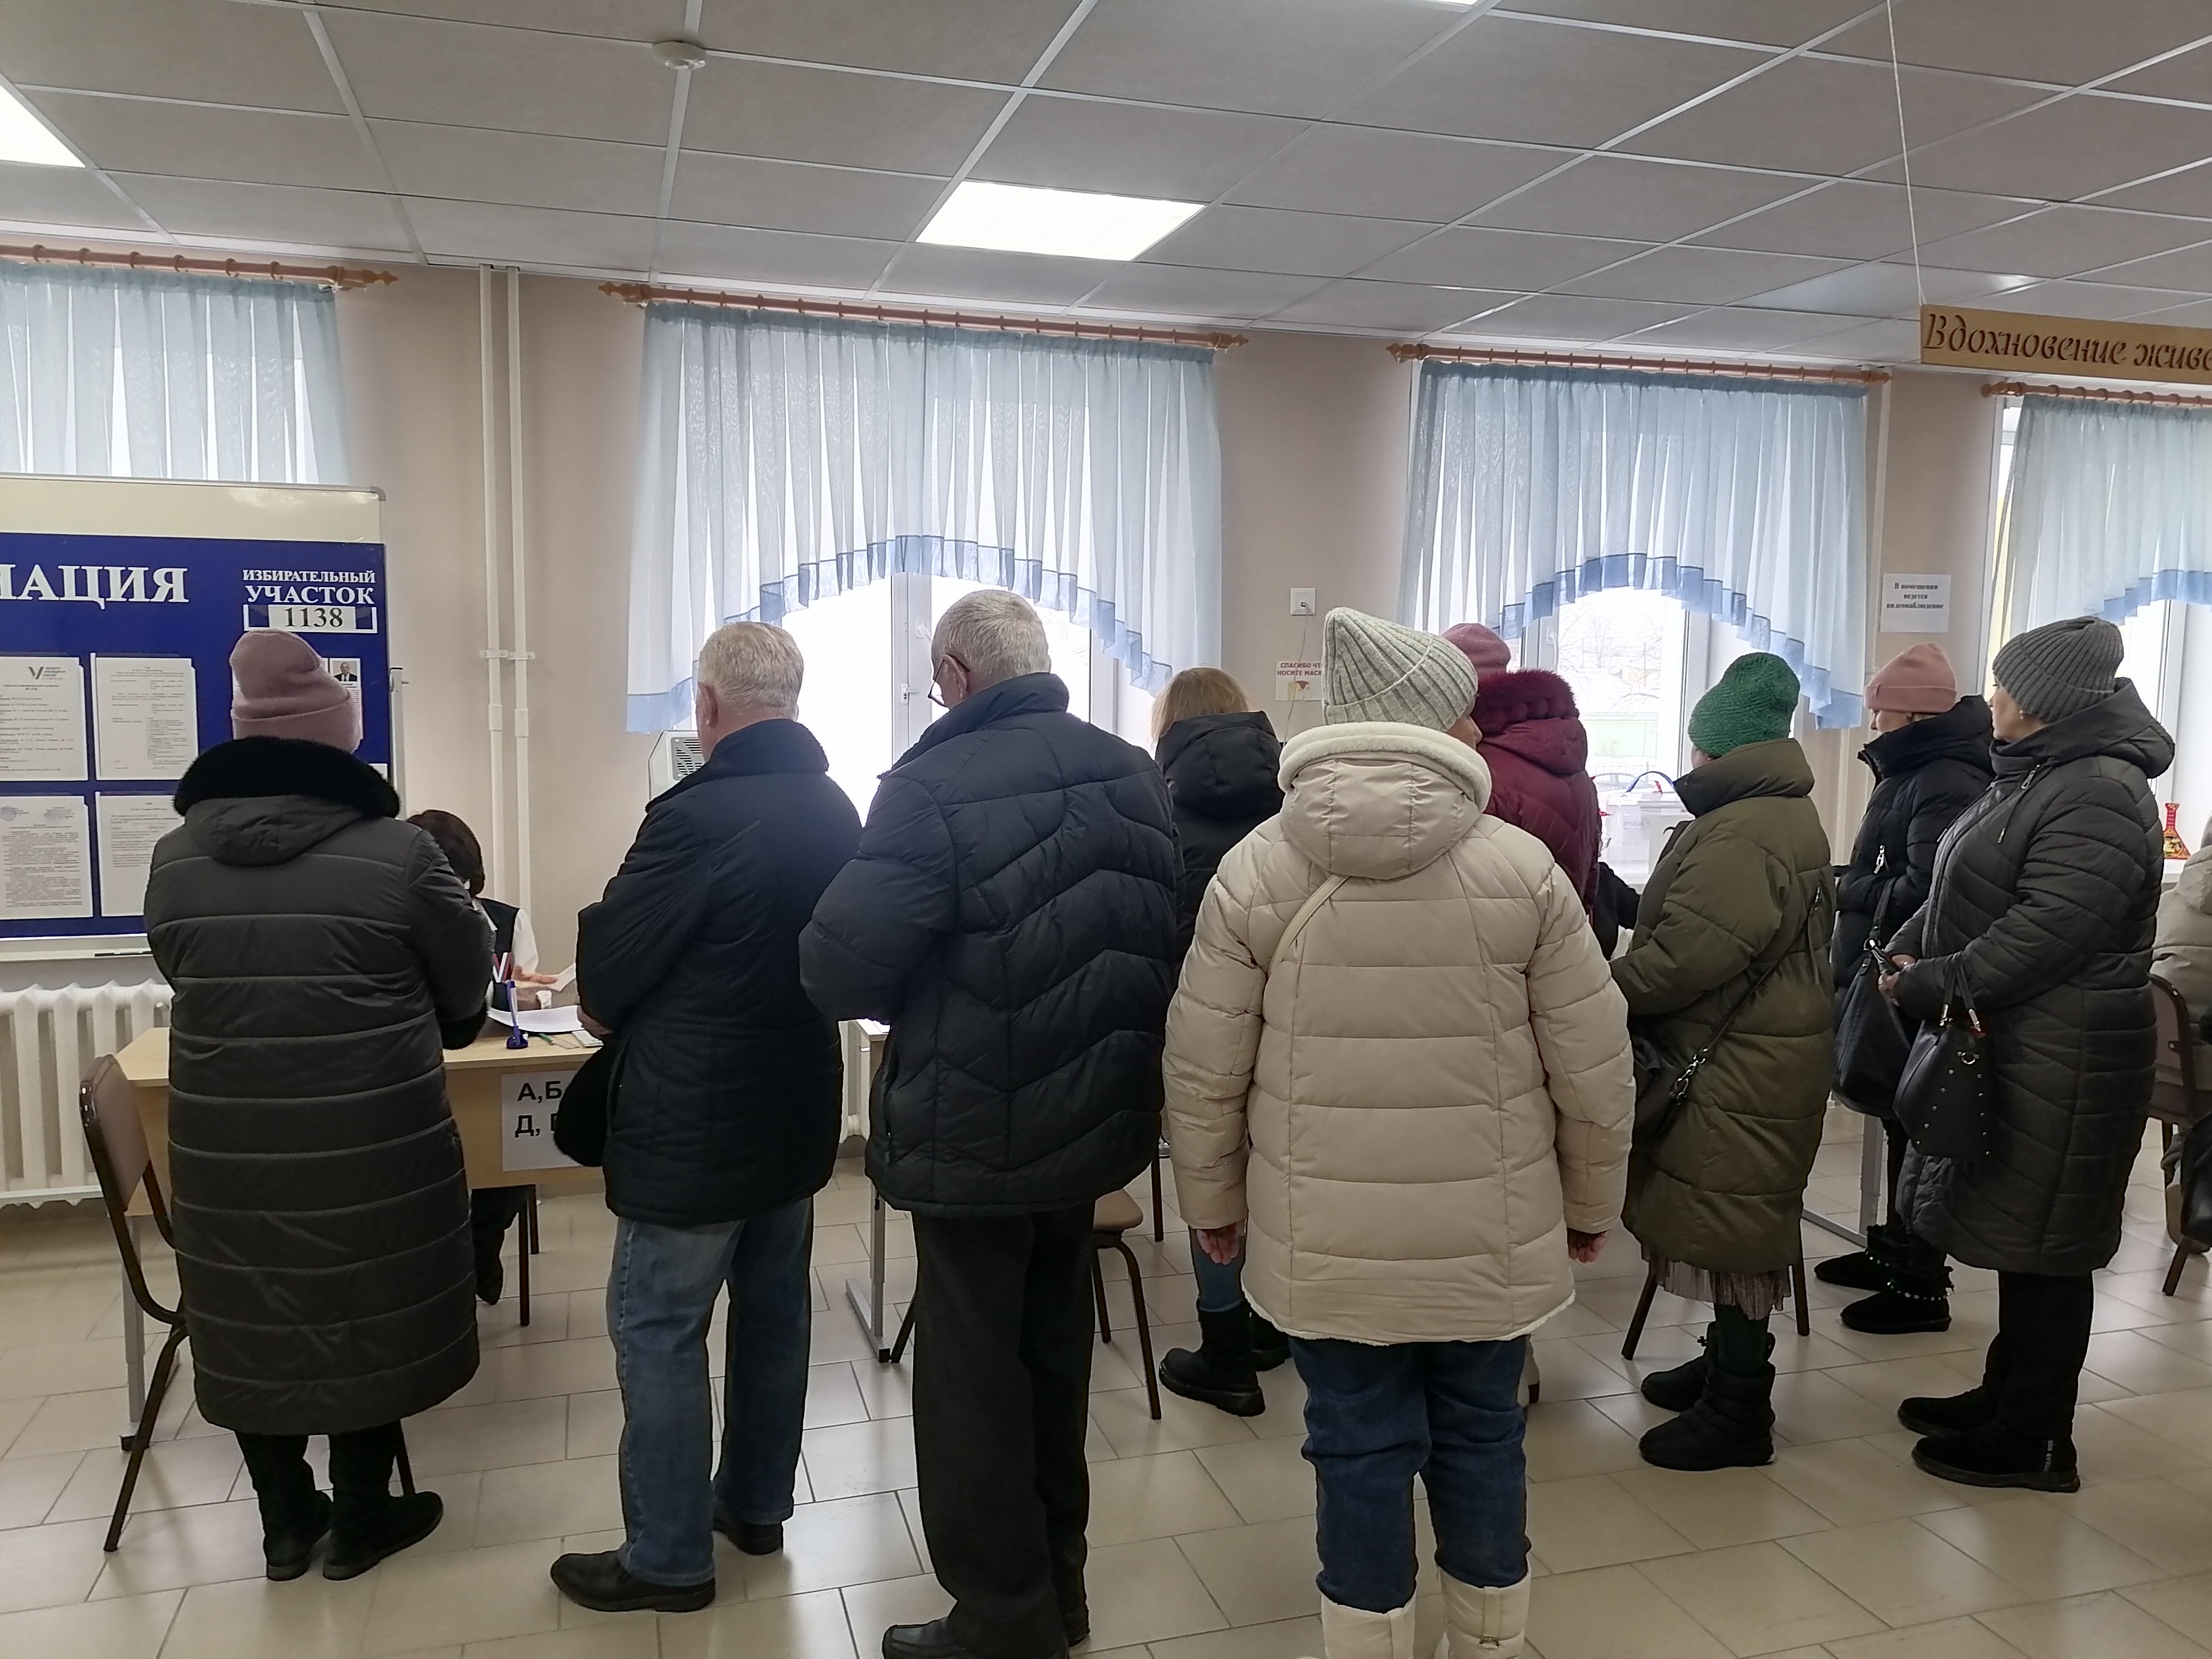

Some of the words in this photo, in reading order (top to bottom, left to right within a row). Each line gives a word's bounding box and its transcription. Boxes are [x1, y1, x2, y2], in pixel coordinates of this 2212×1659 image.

[1923, 313, 2127, 366] Вдохновение
[242, 569, 376, 583] ИЗБИРАТЕЛЬНЫЙ
[244, 585, 375, 604] УЧАСТОК
[284, 607, 343, 628] 1138
